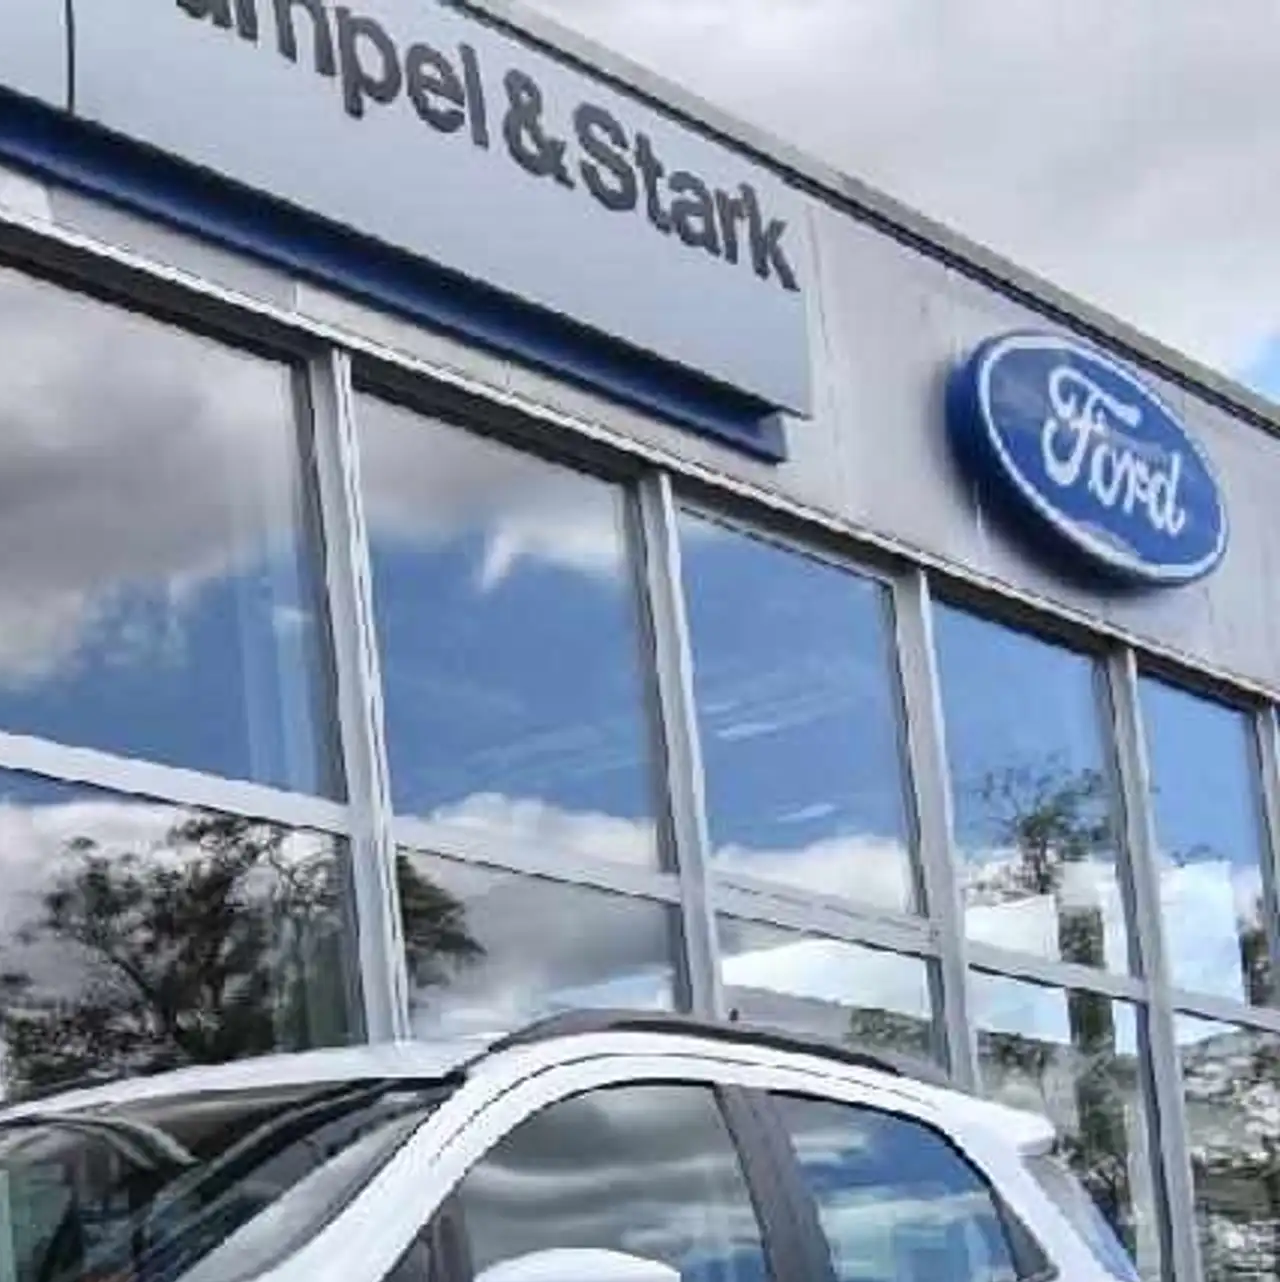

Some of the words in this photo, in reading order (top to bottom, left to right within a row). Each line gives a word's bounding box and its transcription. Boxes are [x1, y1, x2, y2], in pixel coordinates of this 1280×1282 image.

[503, 68, 575, 190] &
[573, 101, 801, 292] Stark
[1043, 365, 1185, 536] Ford
